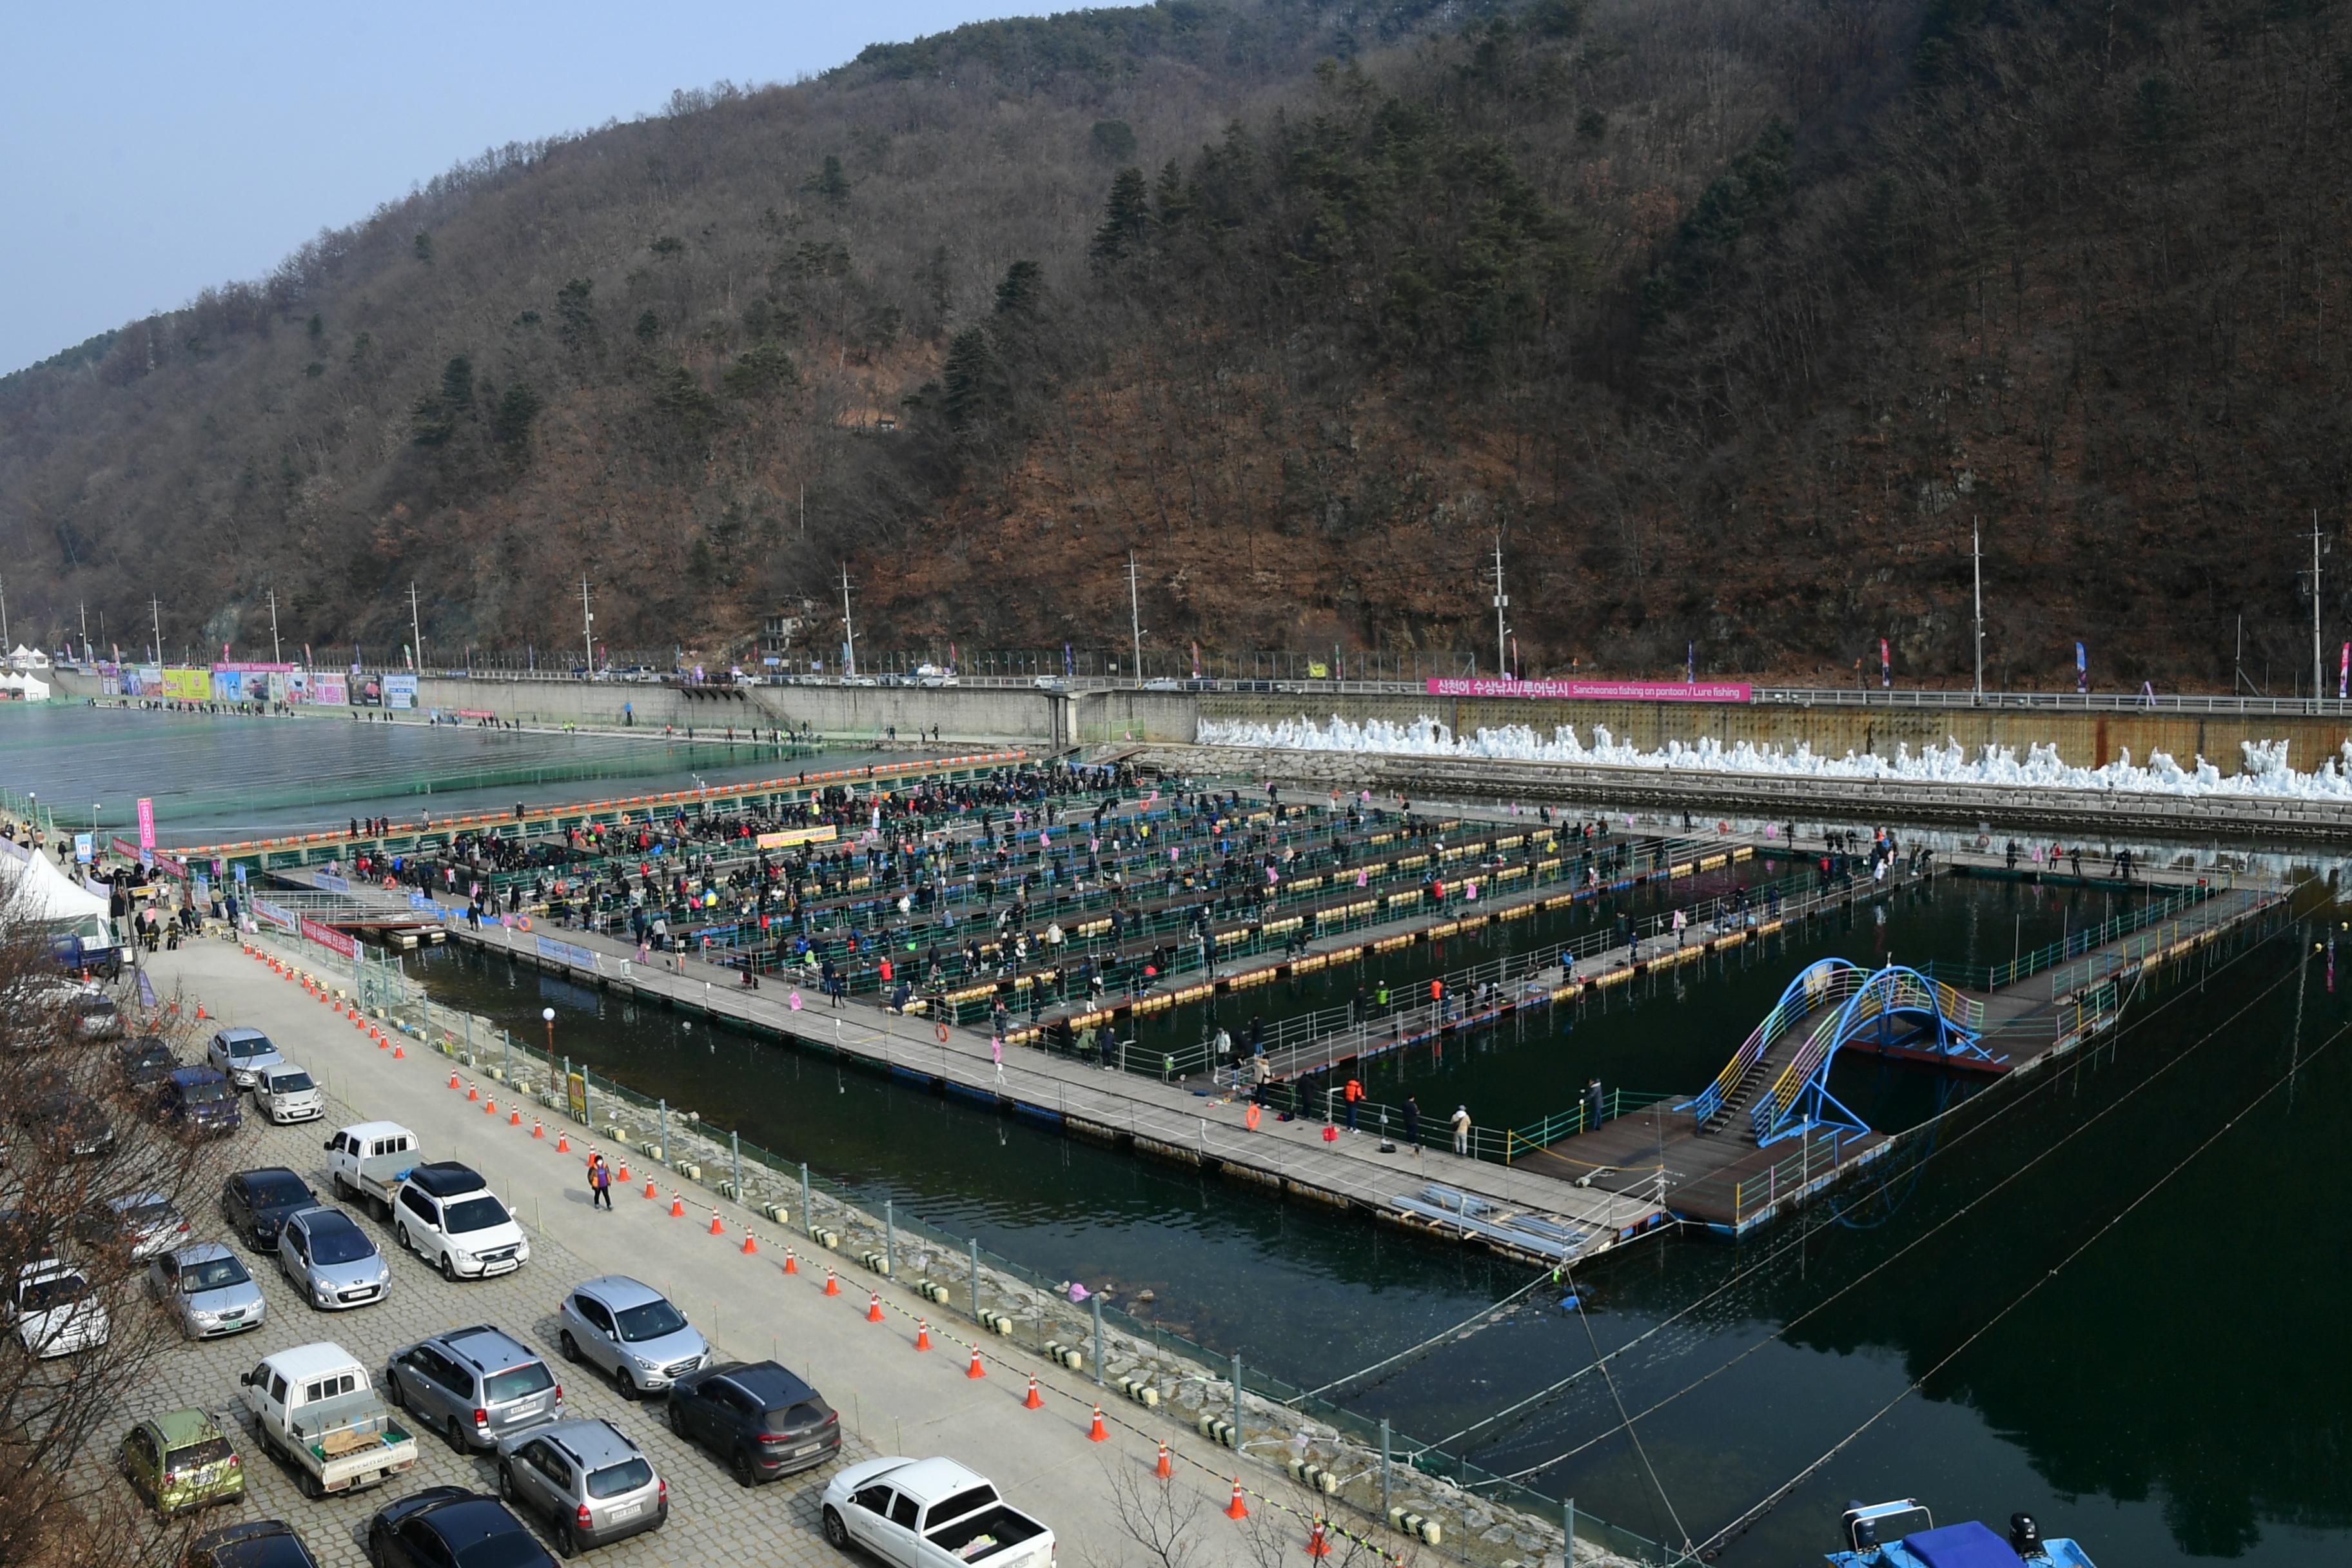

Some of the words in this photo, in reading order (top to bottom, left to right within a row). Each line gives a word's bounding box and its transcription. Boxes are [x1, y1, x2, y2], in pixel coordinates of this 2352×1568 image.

[1438, 680, 1469, 694] 산천어
[1619, 686, 1643, 697] fishing
[1656, 687, 1687, 698] pontoon
[1693, 687, 1712, 696] Lure
[1713, 687, 1740, 699] fishing
[349, 1455, 393, 1471] HYUNDAI
